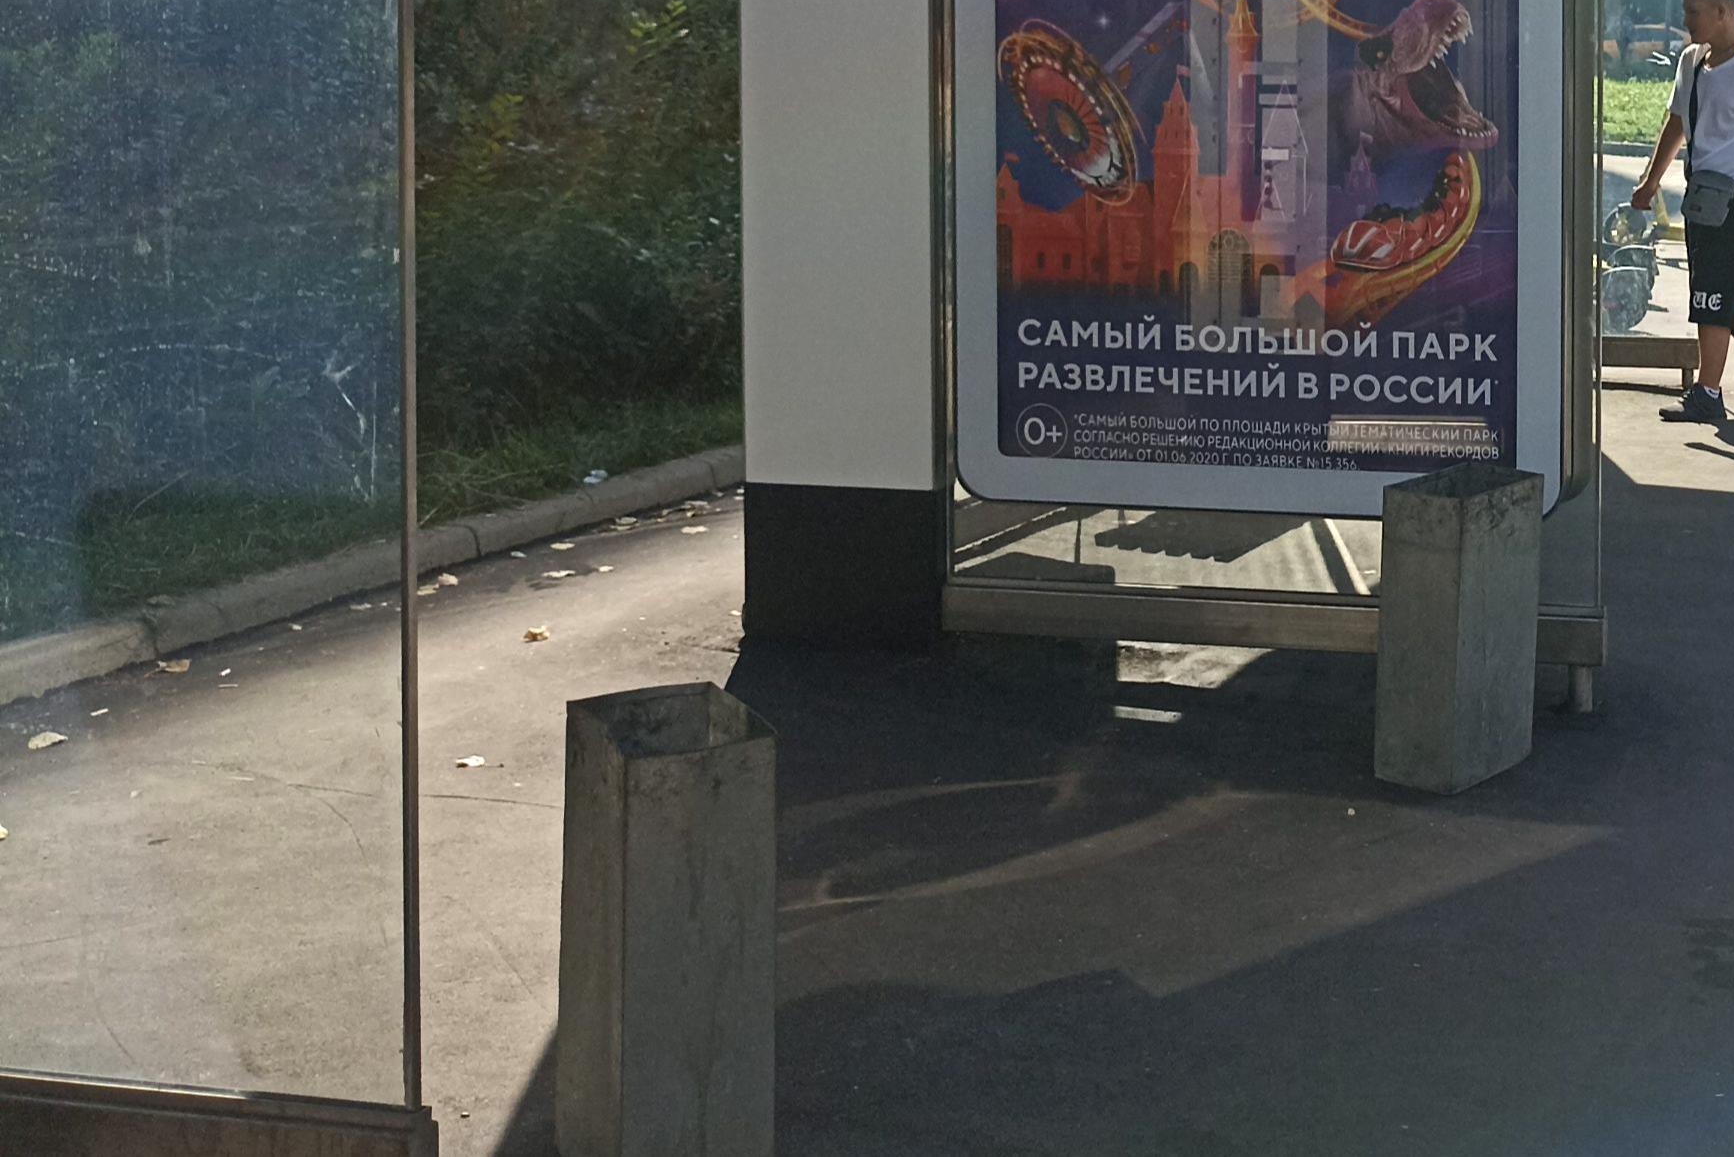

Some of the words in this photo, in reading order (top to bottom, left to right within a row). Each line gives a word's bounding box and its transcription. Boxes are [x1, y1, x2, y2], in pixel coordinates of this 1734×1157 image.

[1018, 315, 1161, 350] САМЫЙ
[1175, 322, 1377, 358] БОЛЬШОЙ
[1392, 331, 1498, 361] ПАРК
[1018, 362, 1286, 399] РАЗВЛЕЧЕНИЙ
[1298, 372, 1319, 399] В
[1023, 417, 1063, 445] 0+
[1130, 414, 1197, 431] БОЛЬШОЙ
[1200, 418, 1220, 432] ПО
[1222, 419, 1291, 435] ПЛОЩАДИ
[1463, 428, 1499, 442] ПАРК
[1073, 430, 1140, 444] СОГЛАСНО
[1142, 432, 1205, 448] РЕШЕНИЮ
[1207, 435, 1311, 452] РЕДАКЦИОННОЙ
[1433, 445, 1500, 460] РЕКОРДОВ
[1136, 449, 1152, 461] ОТ
[1233, 453, 1252, 466] ПО
